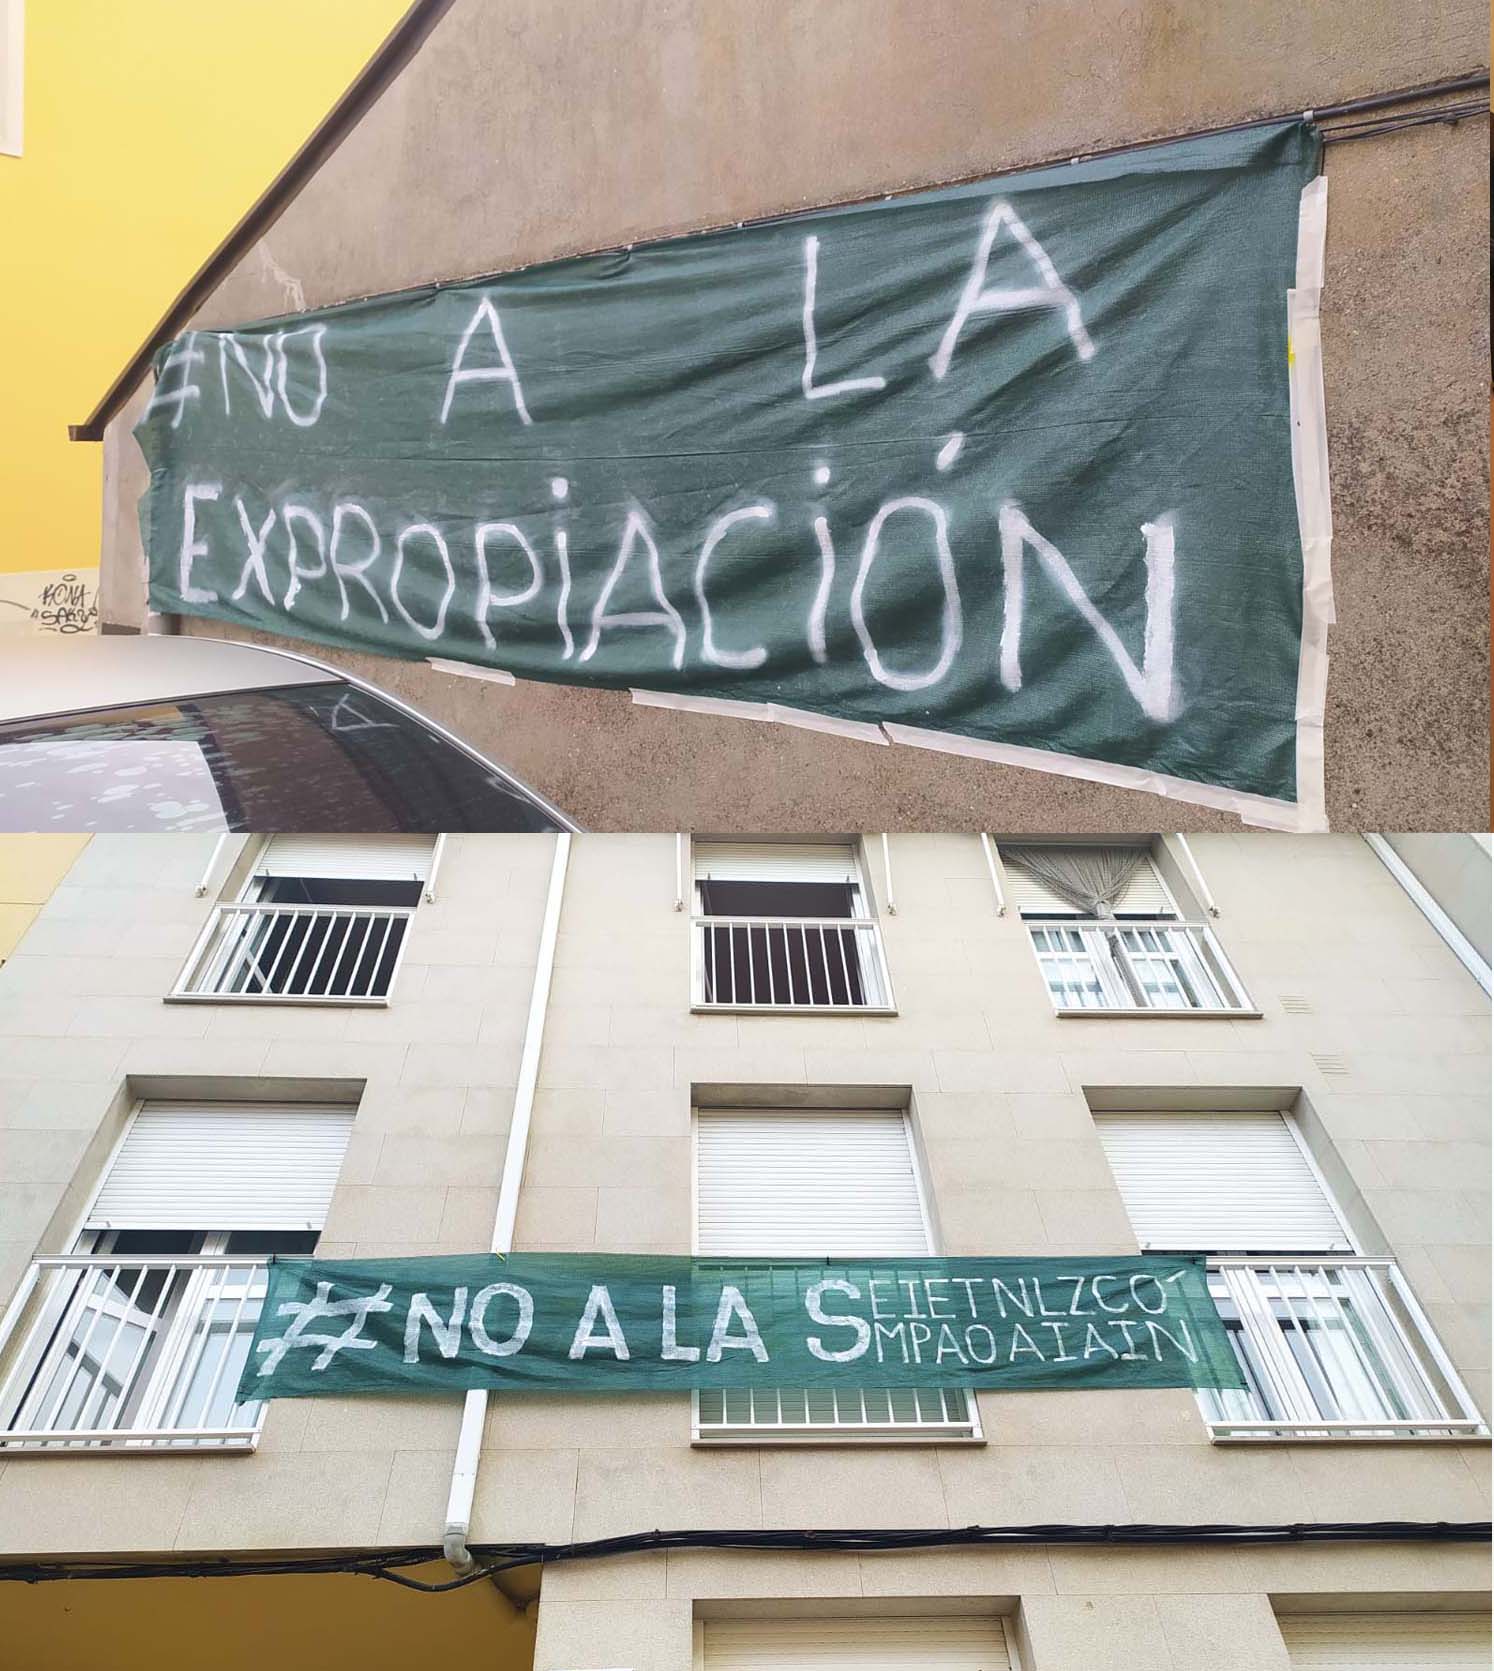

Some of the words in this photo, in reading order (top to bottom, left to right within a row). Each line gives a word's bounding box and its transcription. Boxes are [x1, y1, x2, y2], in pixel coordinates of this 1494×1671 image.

[142, 324, 327, 429] #NO
[441, 298, 534, 425] A
[803, 200, 1097, 400] LA
[256, 1281, 534, 1376] #NO
[568, 1285, 630, 1361] A
[661, 1285, 770, 1362] LA
